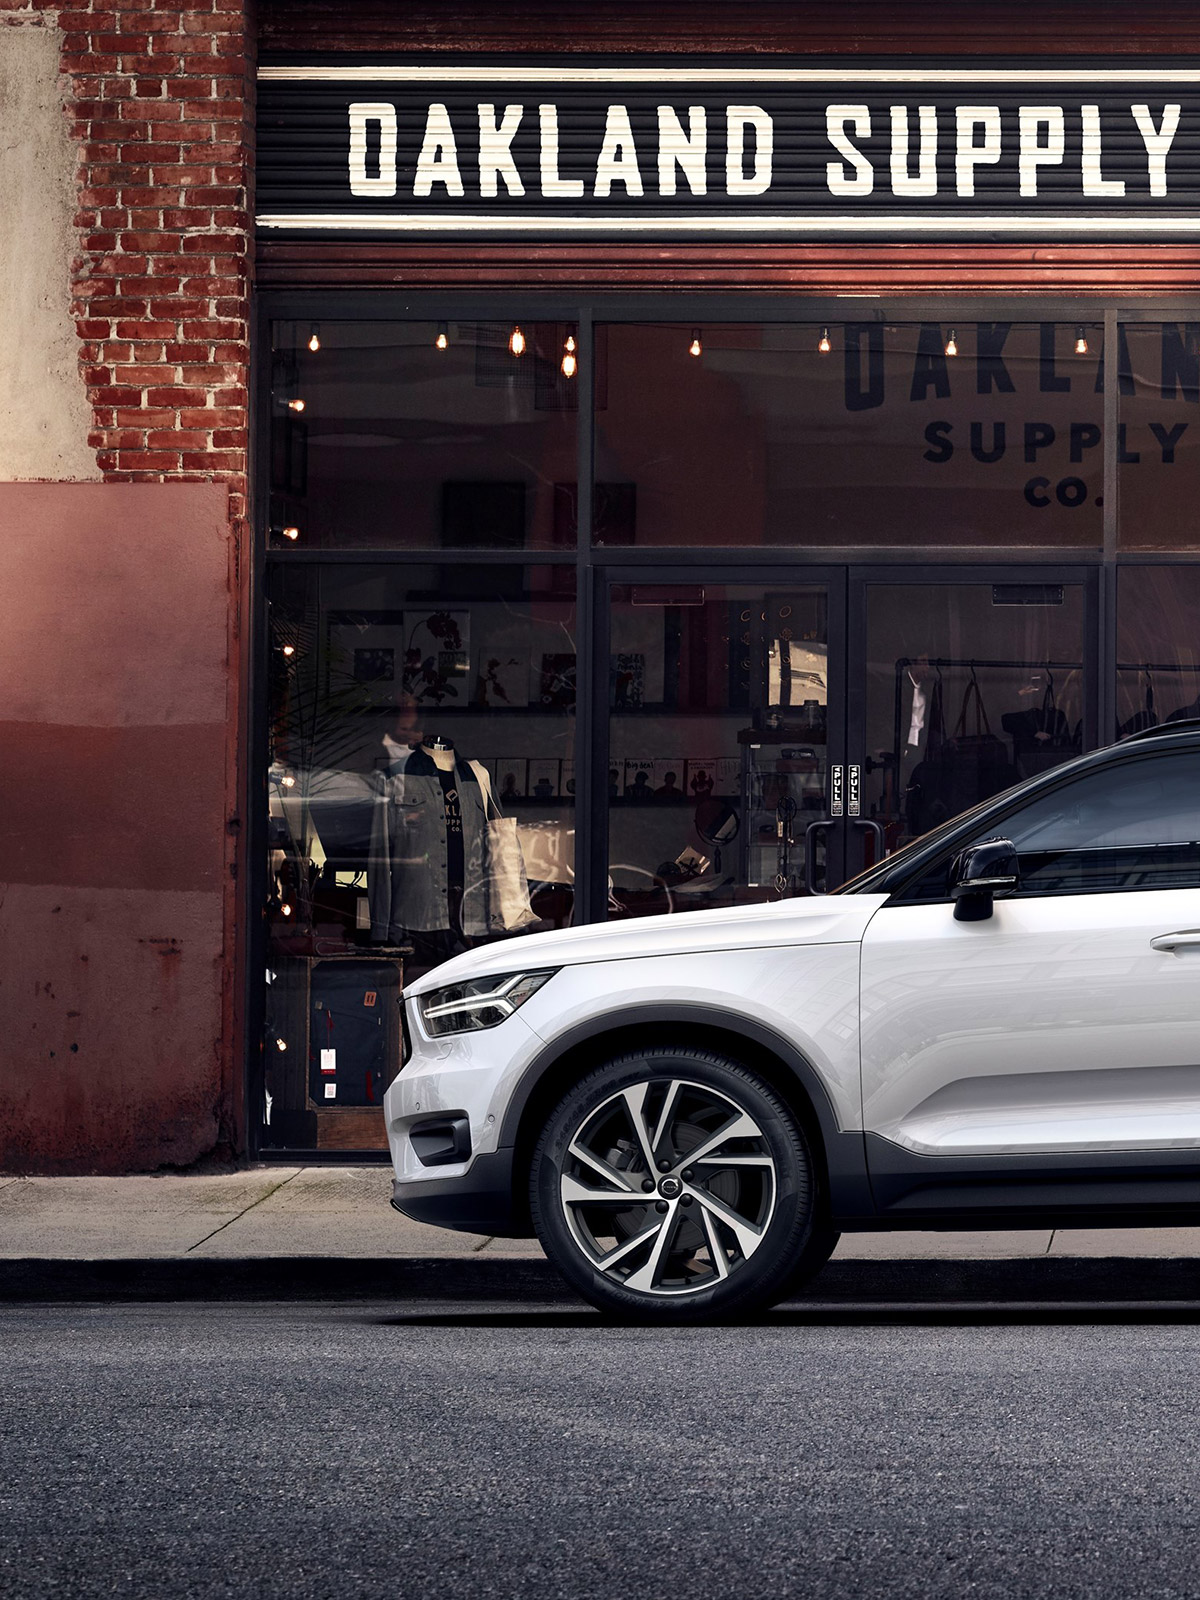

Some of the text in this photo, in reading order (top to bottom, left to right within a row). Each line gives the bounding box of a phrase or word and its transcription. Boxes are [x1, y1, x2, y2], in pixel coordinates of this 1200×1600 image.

[348, 102, 773, 198] OAKLAND
[825, 103, 1181, 198] SUPPLY
[923, 421, 1189, 464] SUPPLY
[1023, 476, 1104, 508] CO.
[833, 772, 841, 801] PULL
[850, 772, 858, 801] PULL
